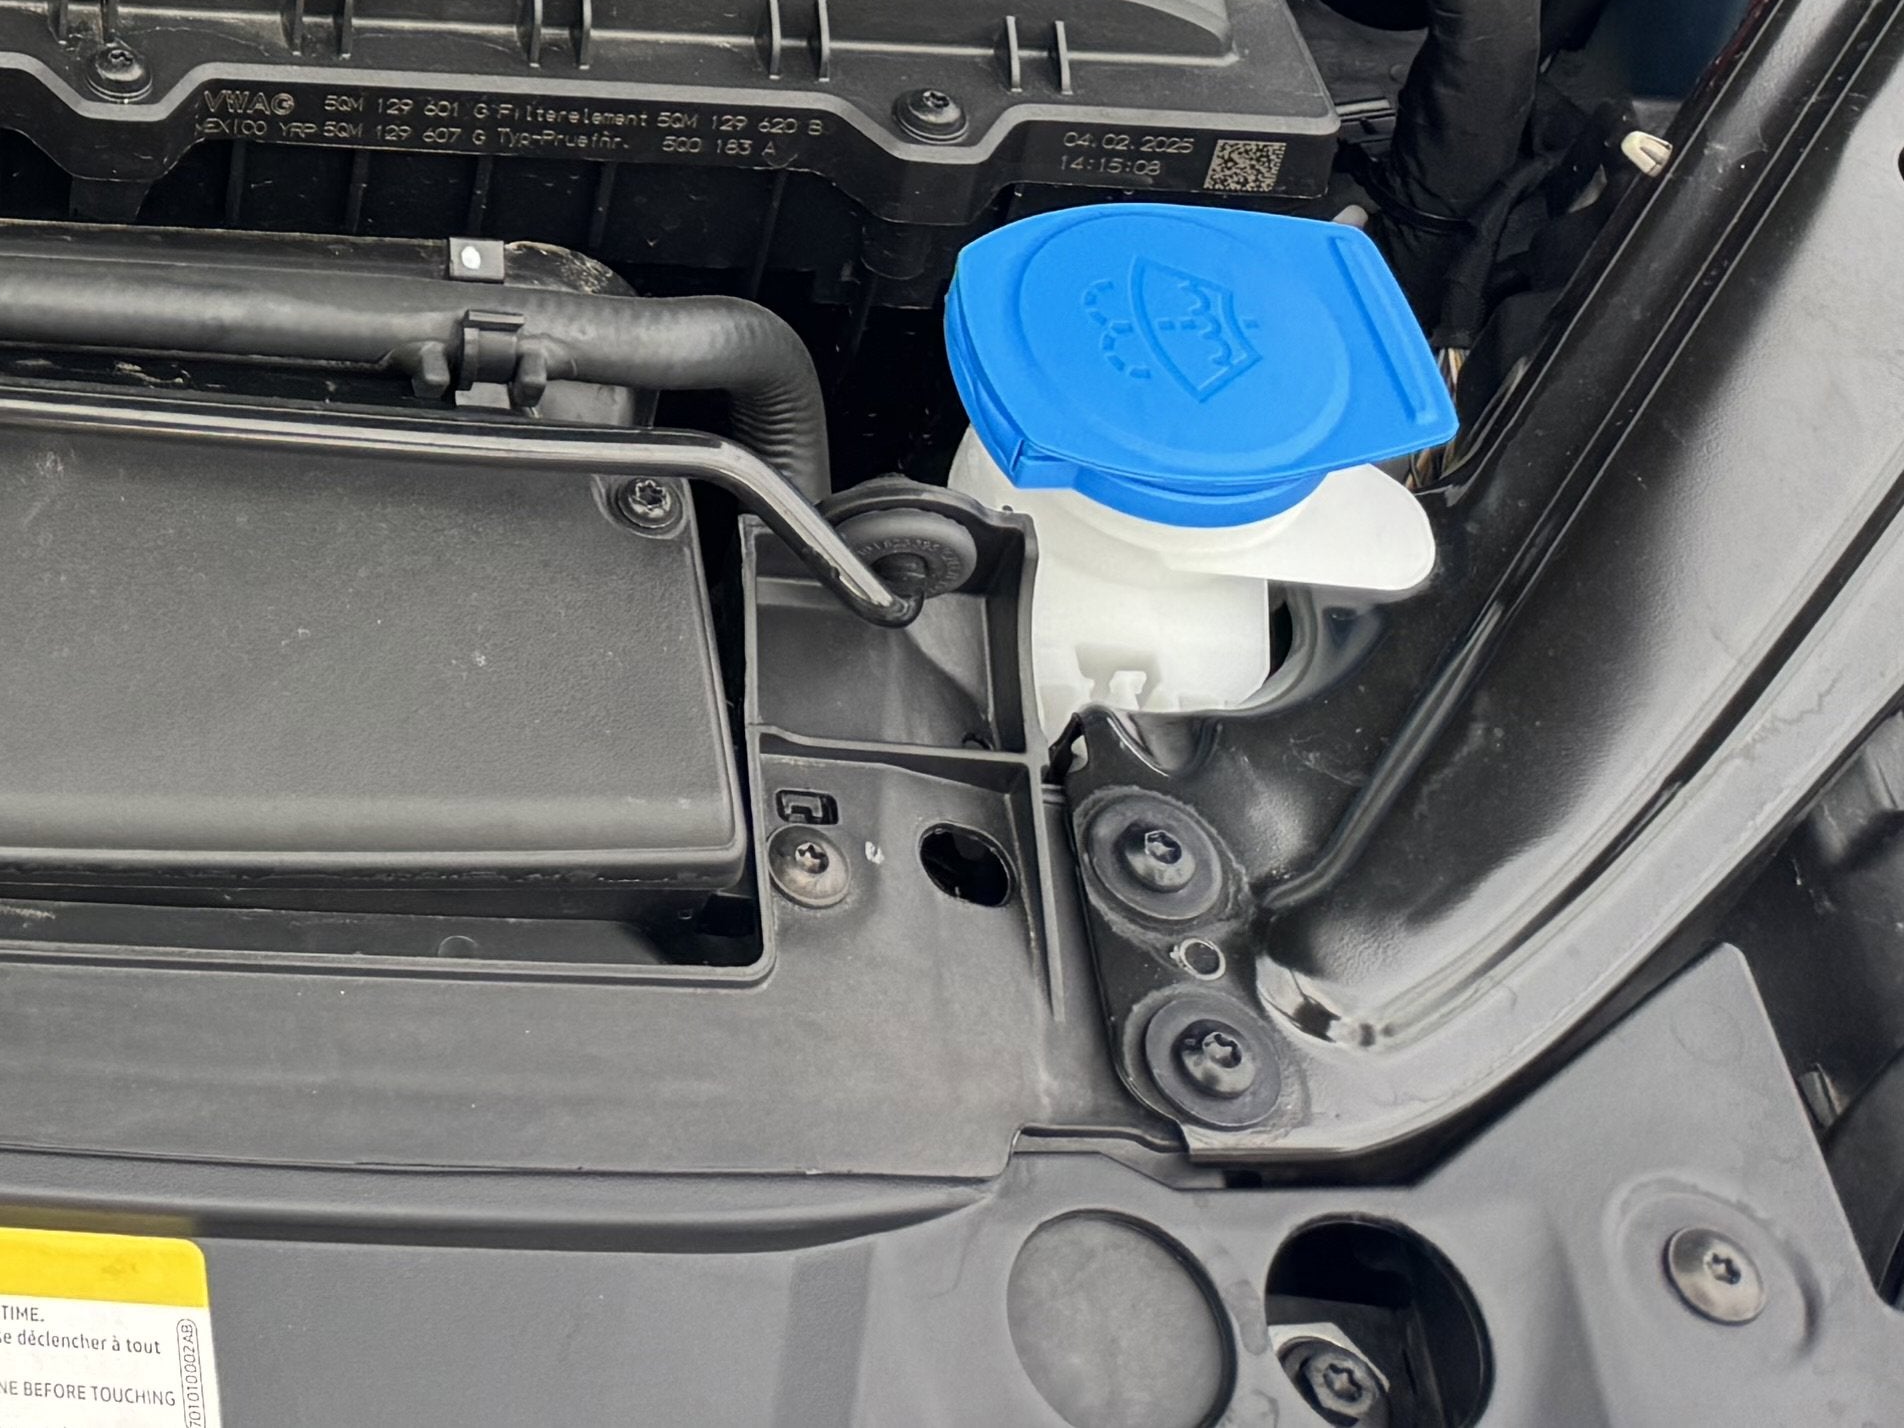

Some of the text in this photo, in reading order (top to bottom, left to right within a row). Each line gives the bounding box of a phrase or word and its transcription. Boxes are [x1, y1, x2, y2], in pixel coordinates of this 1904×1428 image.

[323, 94, 490, 119] 5QM 129 601 G
[496, 103, 648, 128] Filterelement
[656, 111, 698, 130] 5QM
[711, 114, 748, 131] 129
[758, 118, 798, 134] 620
[322, 121, 488, 145] 5QM 129 607 G
[1063, 131, 1195, 154] 04.02.2025
[715, 137, 753, 155] 183
[761, 139, 777, 156] A
[1060, 154, 1161, 177] 14:15:08
[1, 1305, 45, 1323] TIME.
[17, 1329, 108, 1351] déclencher
[111, 1335, 121, 1352] à
[126, 1338, 161, 1355] tout
[23, 1381, 87, 1401] BEFORE
[91, 1385, 176, 1407] TOUCHING
